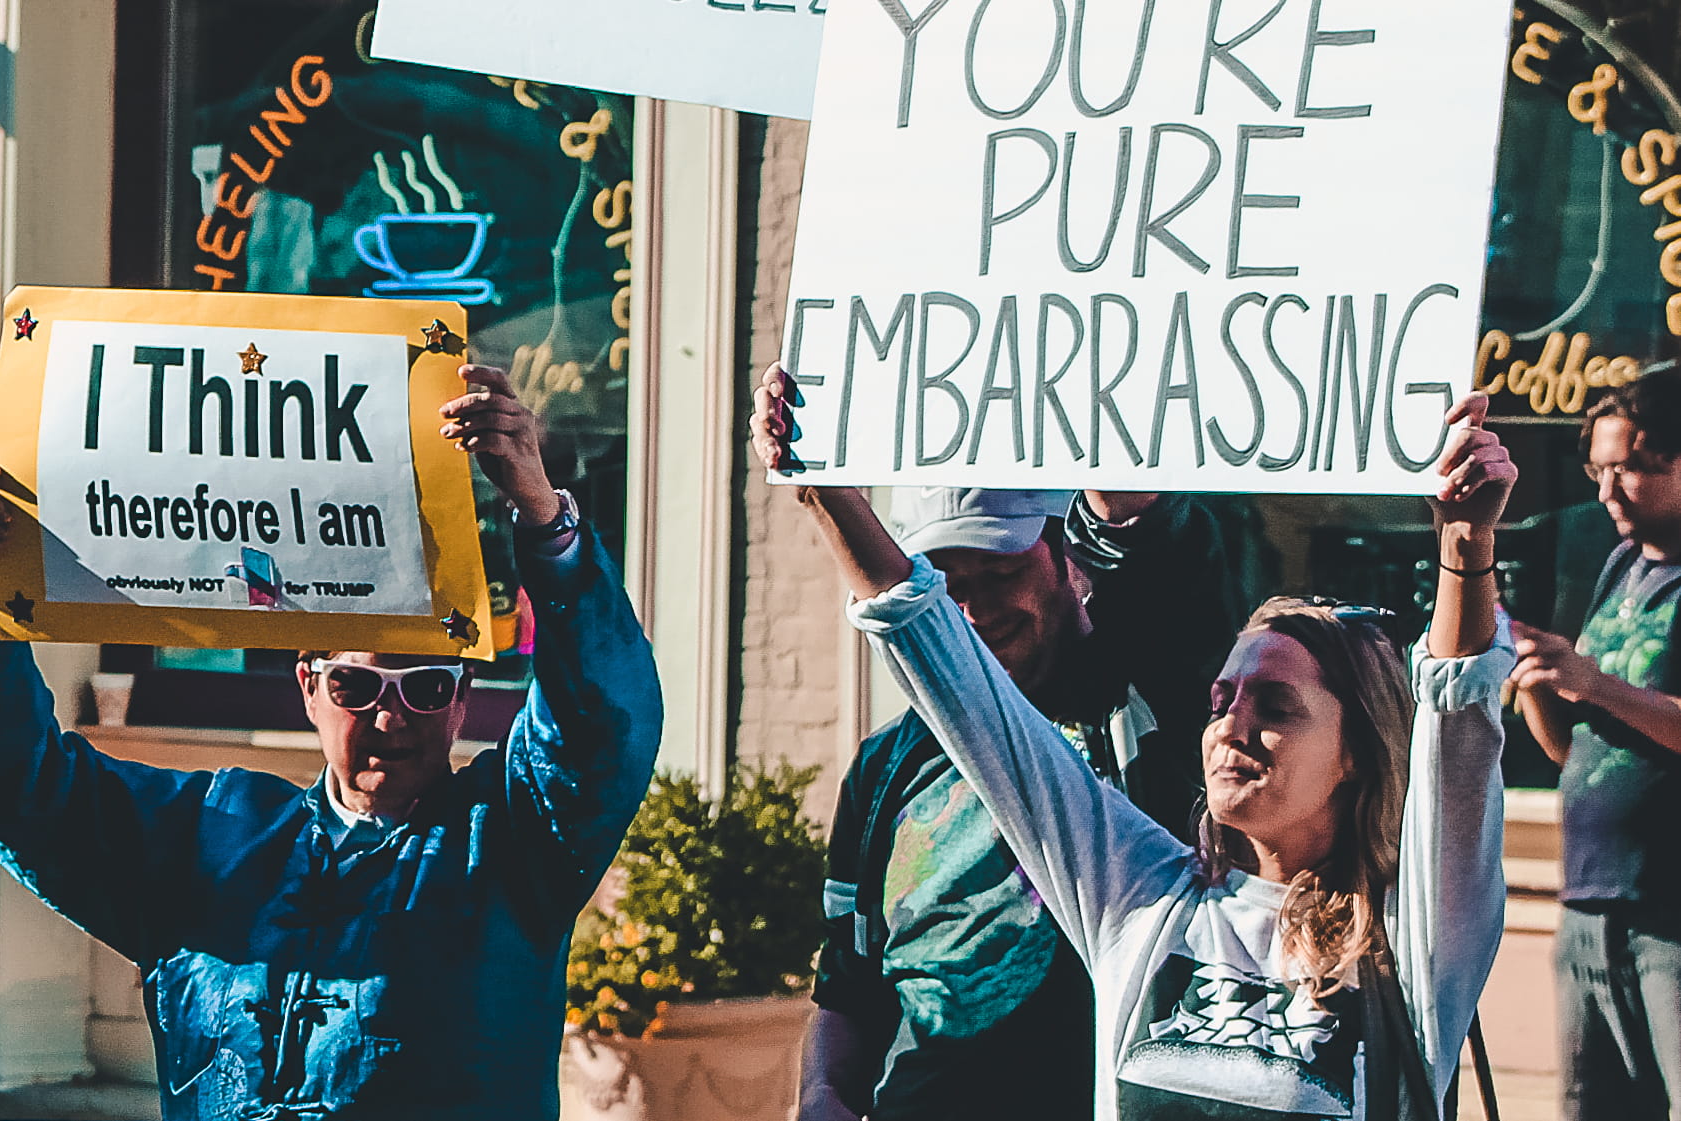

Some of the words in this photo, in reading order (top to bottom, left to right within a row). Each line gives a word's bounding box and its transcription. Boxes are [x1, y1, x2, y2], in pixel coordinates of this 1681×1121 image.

[559, 108, 614, 163] &
[1567, 63, 1622, 135] &
[193, 54, 333, 292] HEELING
[978, 122, 1306, 280] PURE
[84, 344, 105, 450] I
[133, 342, 375, 463] Think
[784, 282, 1460, 473] EMBARRASSING
[1476, 329, 1641, 415] Coffee
[85, 479, 280, 544] therefore
[290, 487, 307, 545] I
[317, 502, 386, 548] am
[106, 575, 185, 593] obviously
[189, 577, 226, 592] NOT
[285, 580, 309, 595] for
[313, 581, 376, 597] TRUMP
